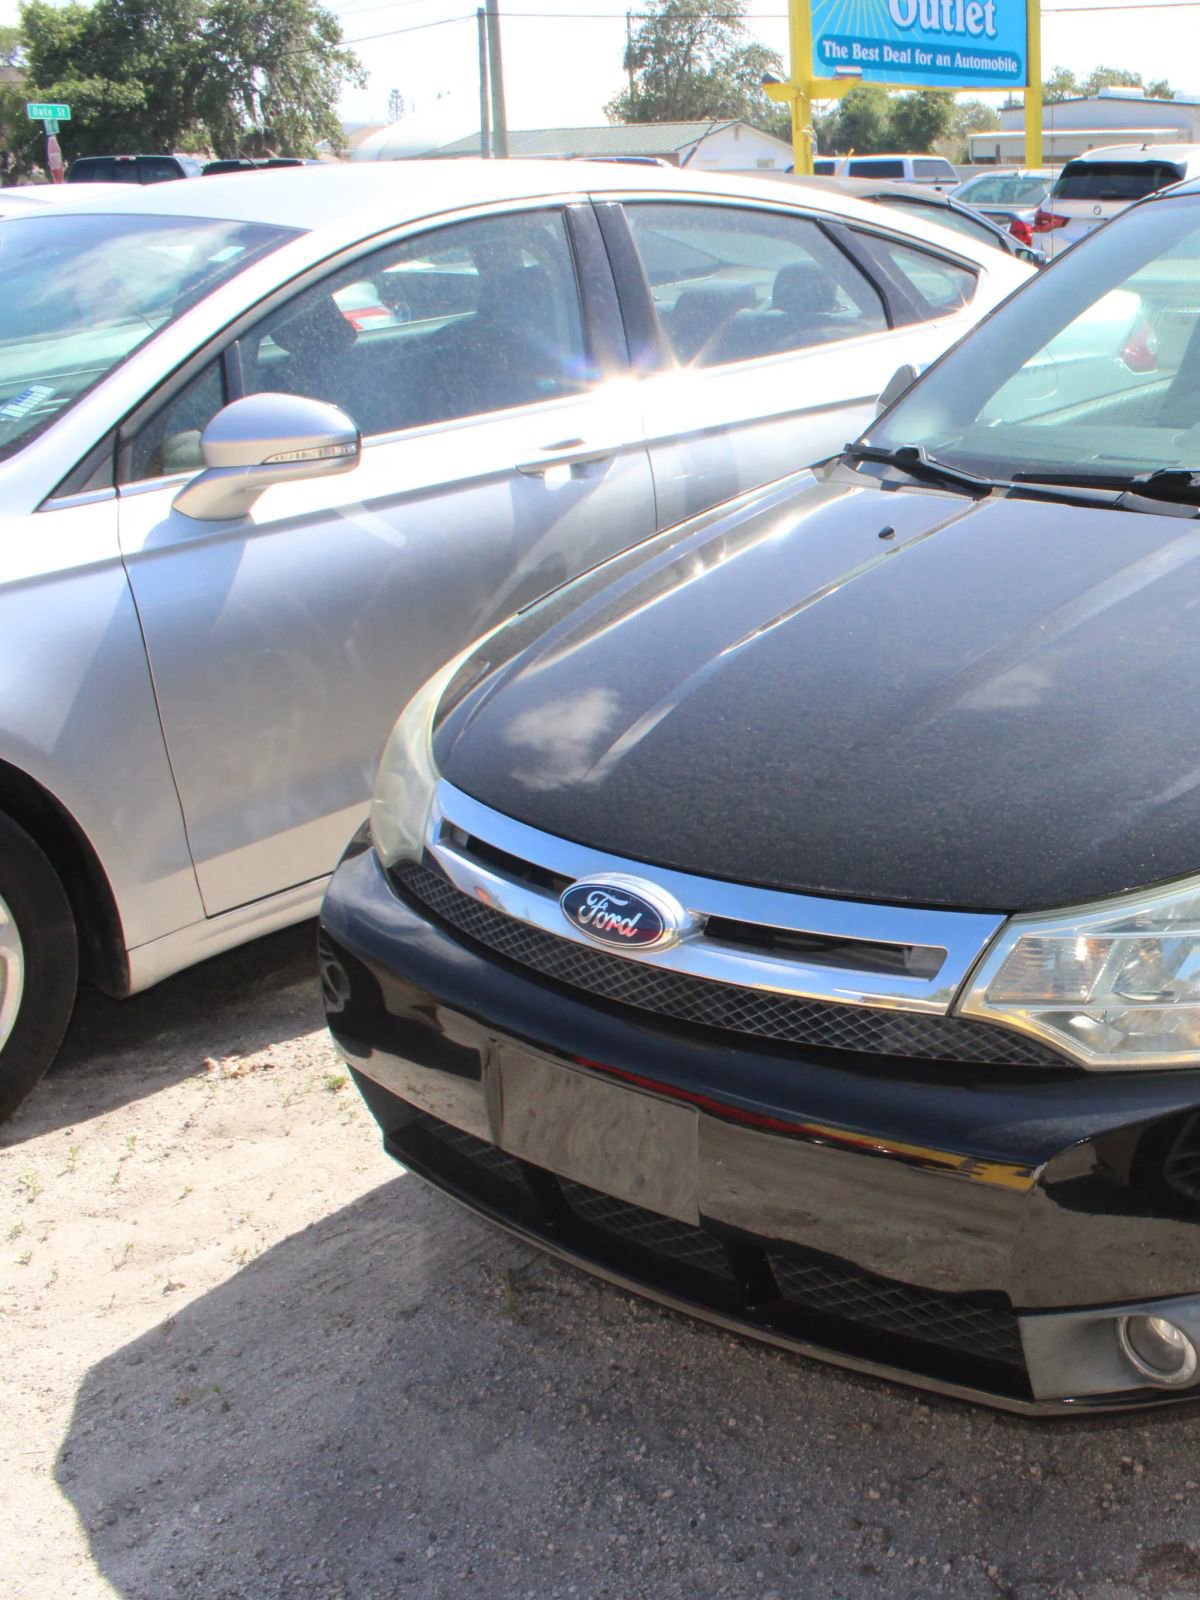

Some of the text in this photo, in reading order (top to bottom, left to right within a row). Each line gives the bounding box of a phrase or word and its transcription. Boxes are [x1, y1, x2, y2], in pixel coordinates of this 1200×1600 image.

[889, 0, 997, 37] Outlet
[823, 40, 1018, 72] The Best Deal for an Automobile
[578, 890, 642, 938] Ford
